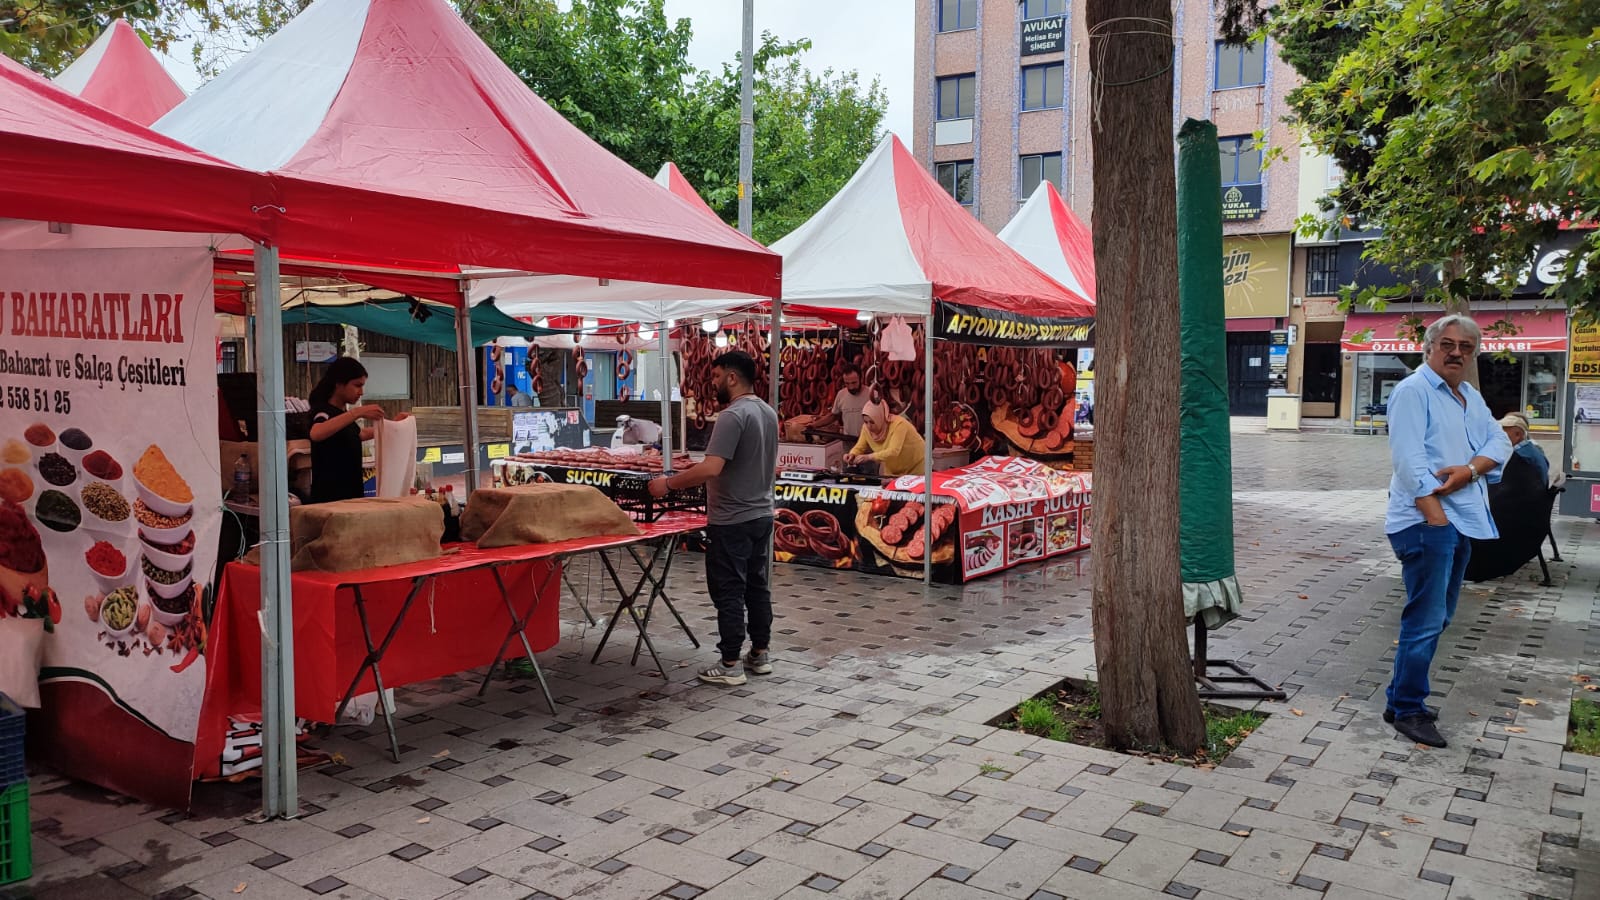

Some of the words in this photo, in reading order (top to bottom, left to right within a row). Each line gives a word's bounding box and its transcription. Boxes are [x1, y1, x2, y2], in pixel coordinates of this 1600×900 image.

[1024, 19, 1063, 33] AVUKAT
[1048, 32, 1062, 40] Ezgi
[1223, 250, 1251, 273] ajin
[1224, 266, 1249, 286] ezi
[11, 291, 184, 343] BAHARATLARI
[947, 313, 997, 338] AFYON
[995, 319, 1039, 342] KASAP
[1036, 324, 1089, 342] SUCUKLARI
[1372, 341, 1416, 351] ÖZLER
[1480, 342, 1532, 351] AKKABI
[0, 349, 51, 378] Baharat
[56, 359, 71, 379] ve
[75, 352, 113, 389] Salça
[118, 355, 186, 392] Çeşitleri
[1573, 363, 1600, 373] BDS
[8, 386, 31, 411] 558
[34, 388, 49, 412] 51
[54, 390, 71, 414] 25
[780, 452, 812, 466] güven
[566, 470, 616, 487] SUCUK
[774, 485, 848, 504] CUKLARI
[981, 500, 1037, 526] KASAP
